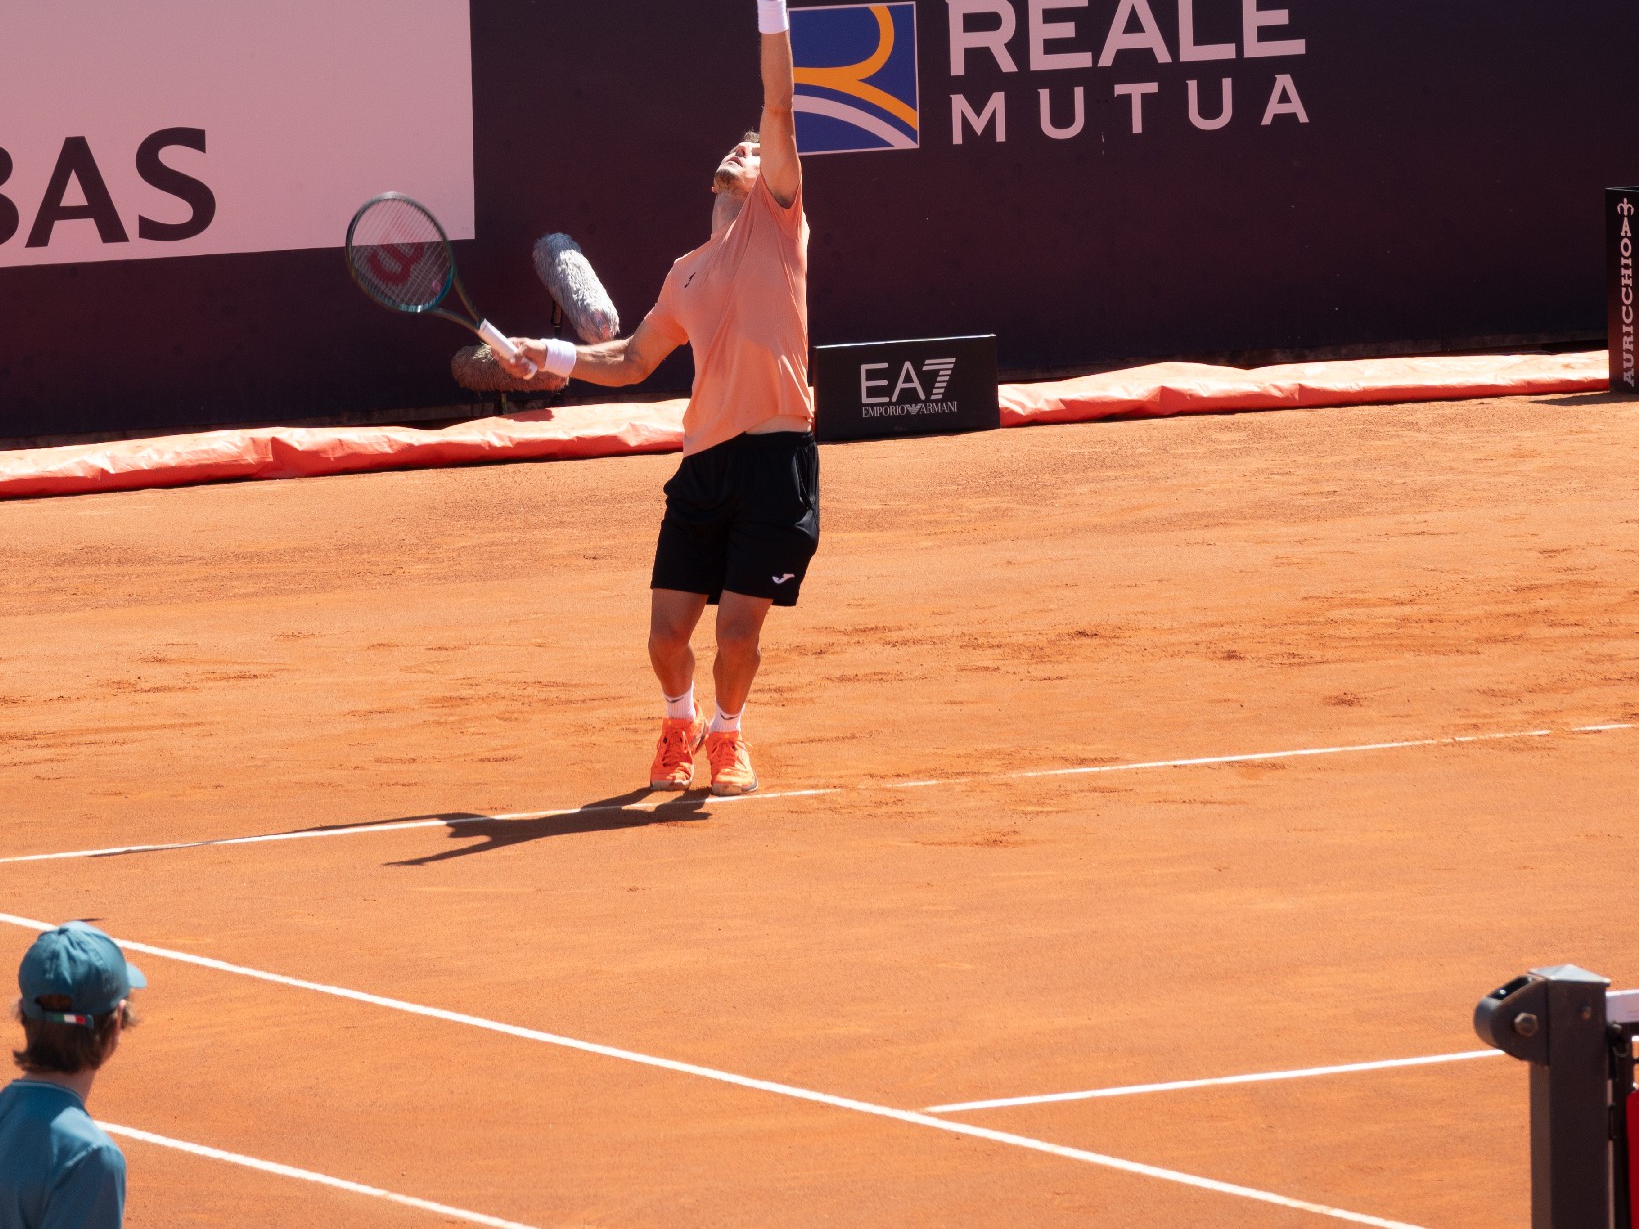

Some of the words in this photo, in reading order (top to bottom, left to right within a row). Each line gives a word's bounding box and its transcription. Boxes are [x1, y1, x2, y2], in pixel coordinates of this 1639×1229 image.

[950, 74, 1309, 145] MUTUA
[1620, 237, 1635, 388] AURICCHIO
[860, 357, 957, 404] EA7
[862, 404, 908, 418] EMPORIO
[919, 401, 958, 415] ARMANI
